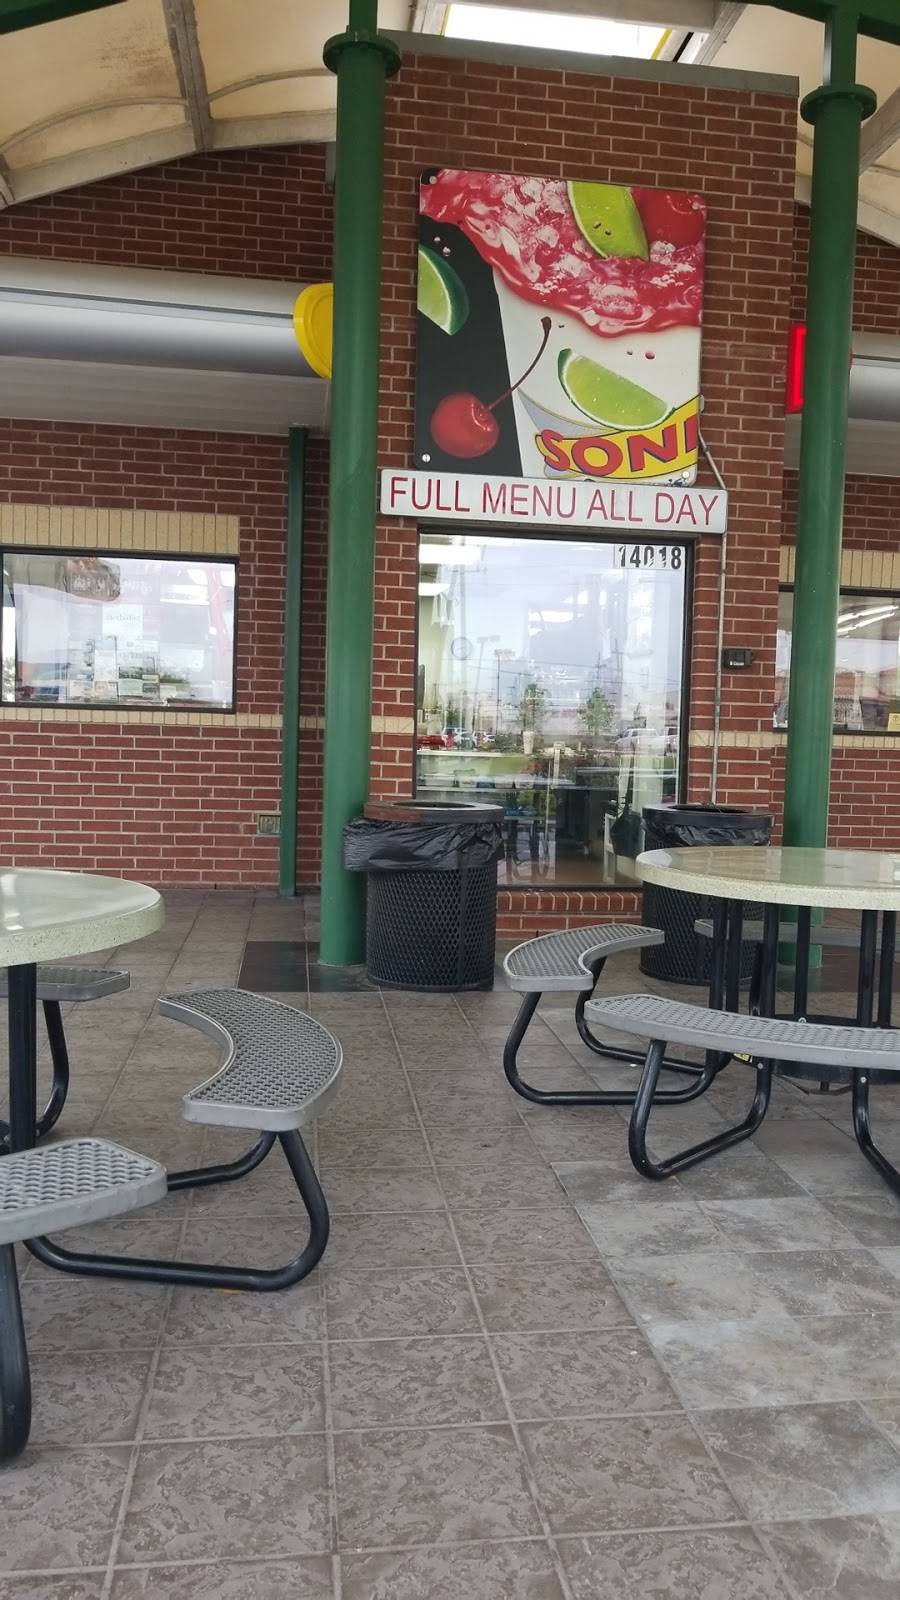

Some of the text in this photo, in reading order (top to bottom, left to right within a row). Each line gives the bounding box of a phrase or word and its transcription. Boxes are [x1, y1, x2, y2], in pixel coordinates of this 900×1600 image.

[389, 476, 719, 526] FULL MENU ALL DAY
[618, 545, 682, 570] 14018
